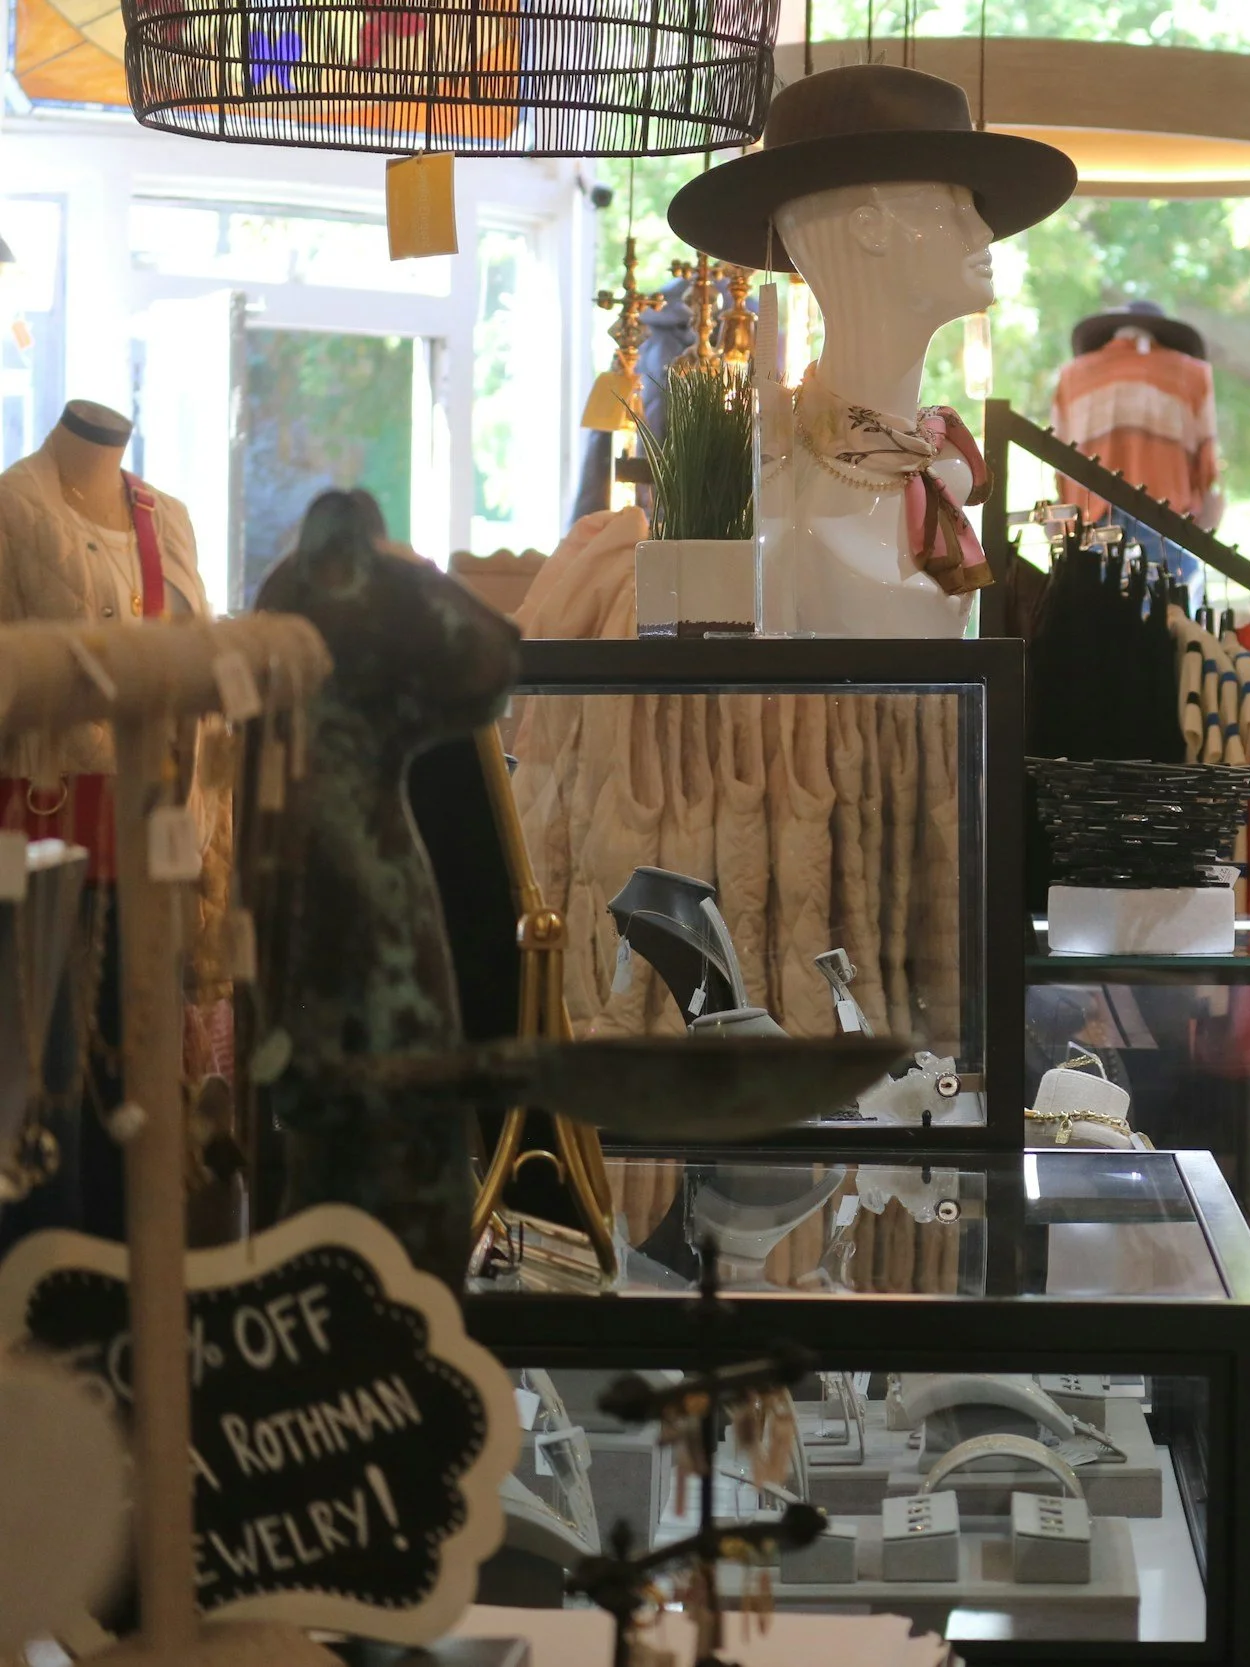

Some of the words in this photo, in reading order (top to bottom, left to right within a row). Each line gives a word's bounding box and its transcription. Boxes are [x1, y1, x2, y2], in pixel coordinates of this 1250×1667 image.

[233, 1285, 331, 1370] OFF
[219, 1375, 423, 1476] ROTHMAN
[192, 1463, 408, 1586] EWELRY!
